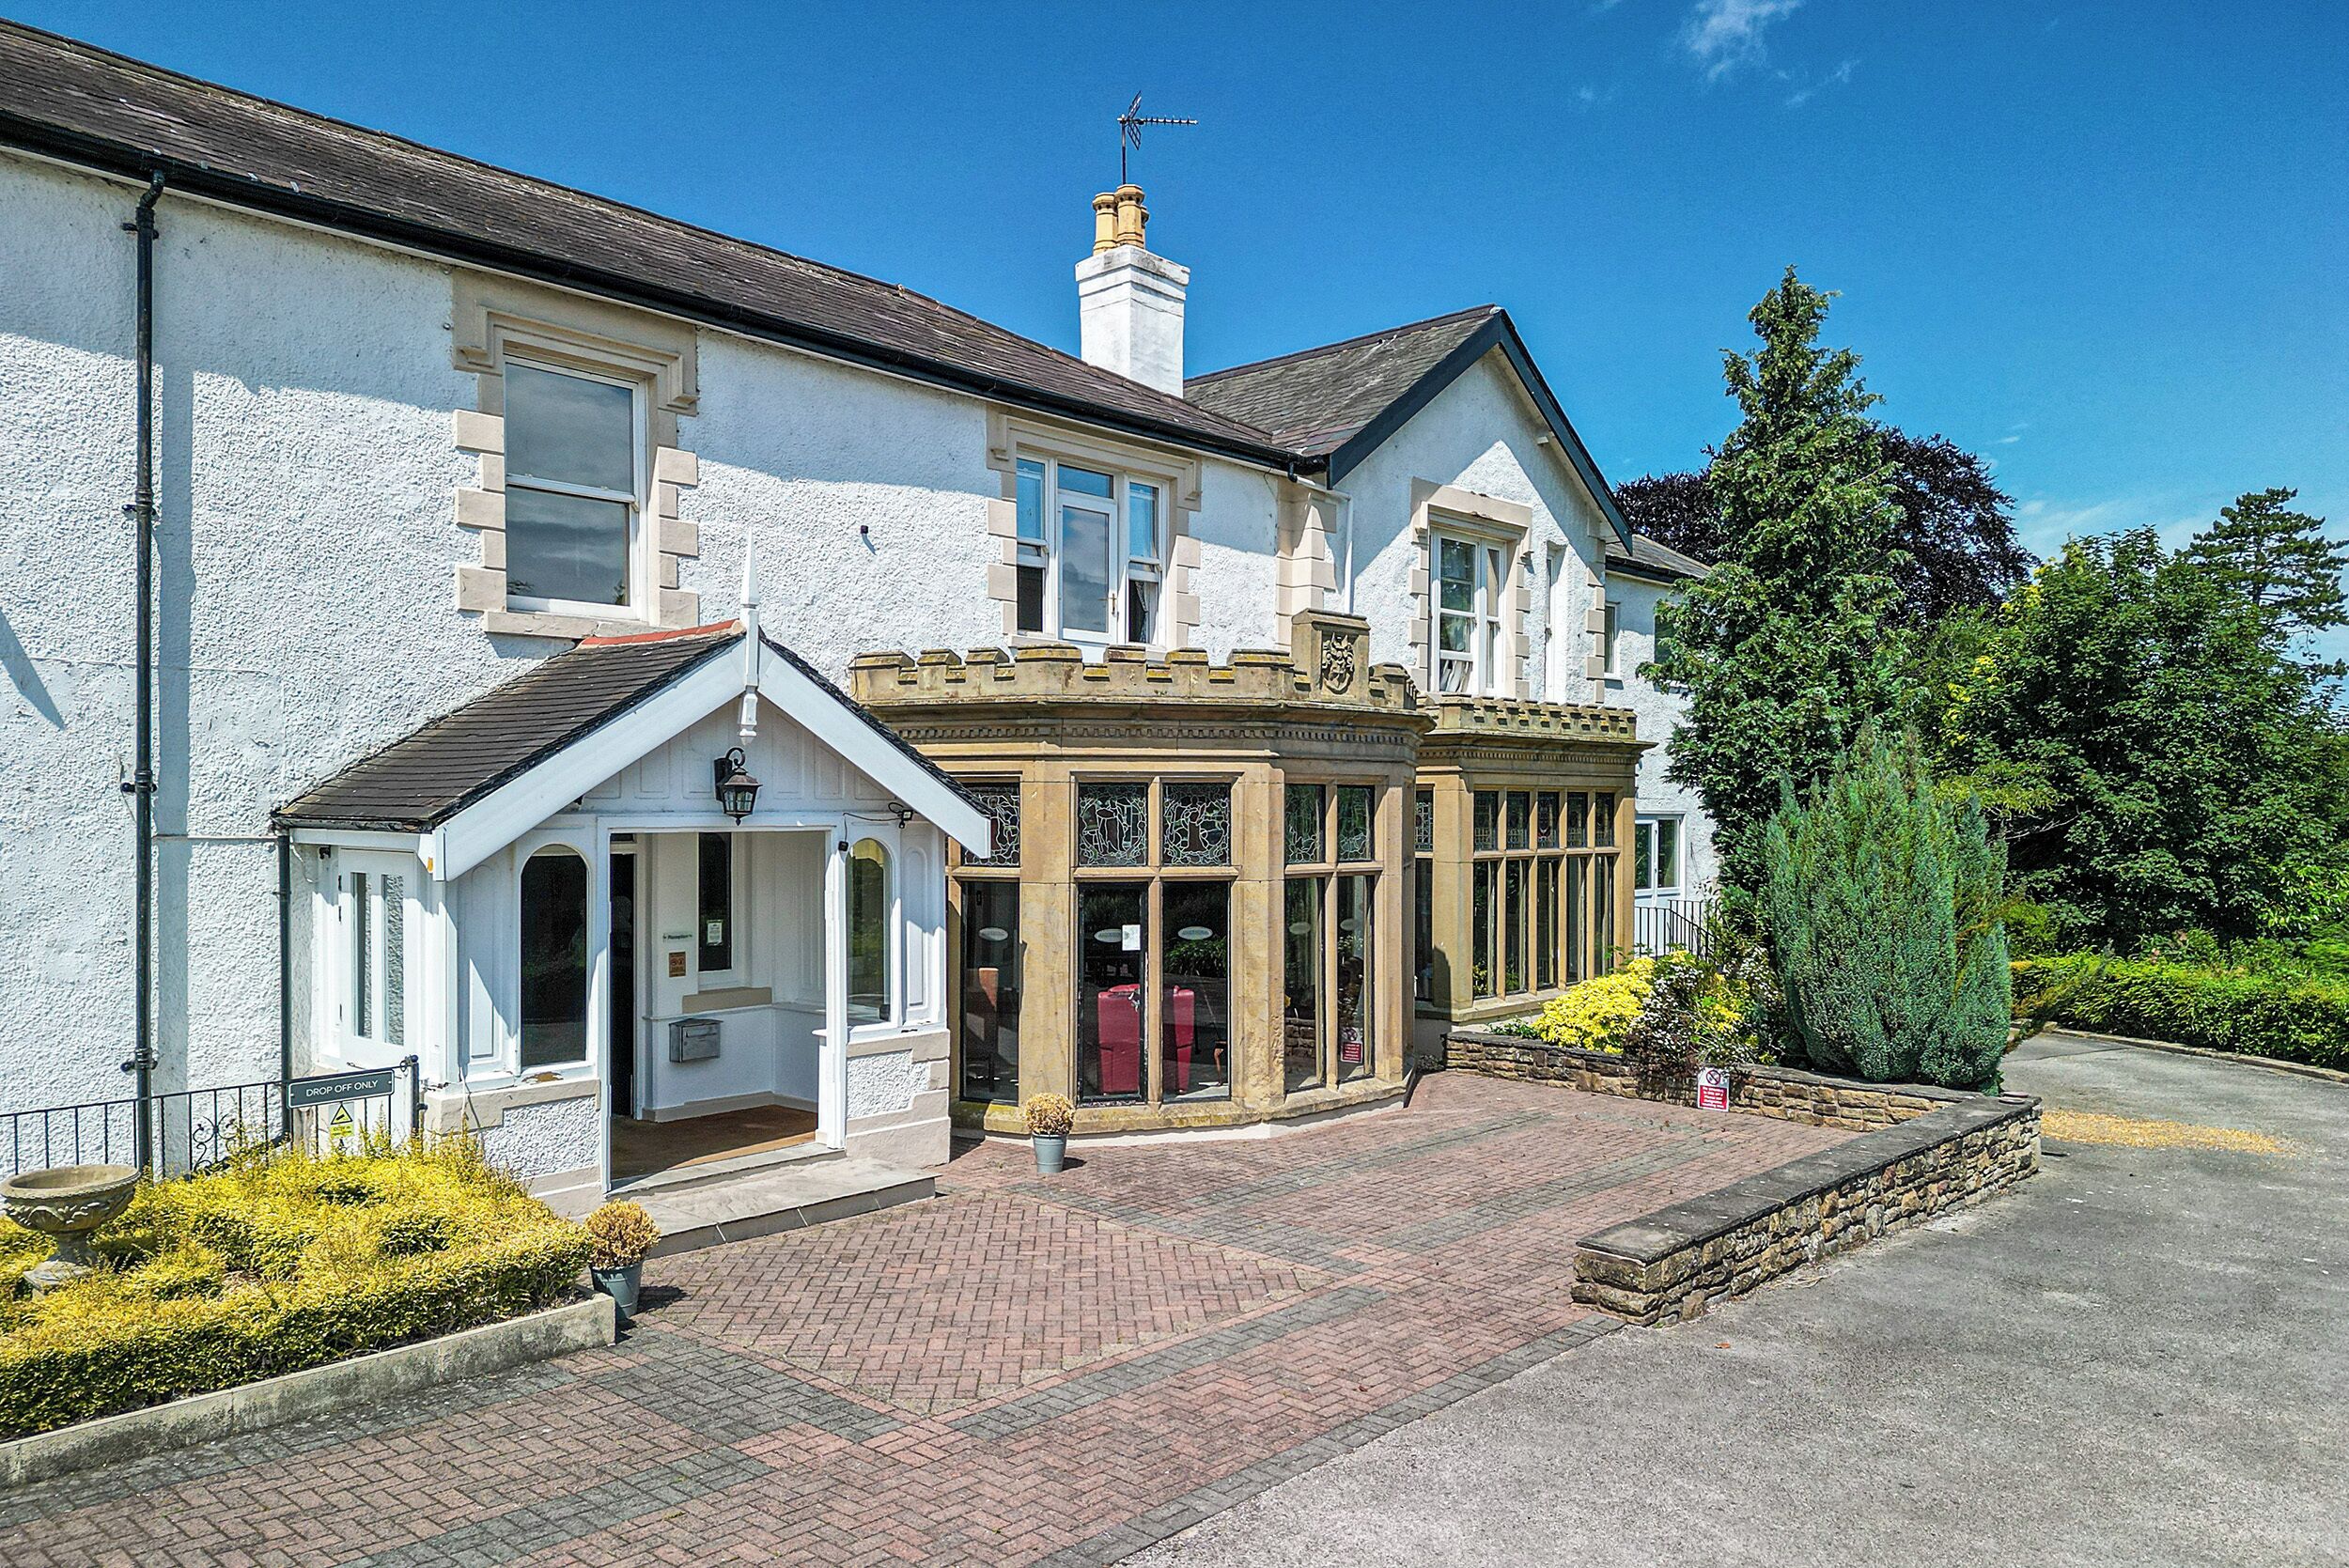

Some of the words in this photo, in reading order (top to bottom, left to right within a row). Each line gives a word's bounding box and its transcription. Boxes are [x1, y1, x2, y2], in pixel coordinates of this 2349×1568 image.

[305, 1086, 333, 1097] DROP
[334, 1083, 352, 1093] OFF
[353, 1079, 378, 1090] ONLY
